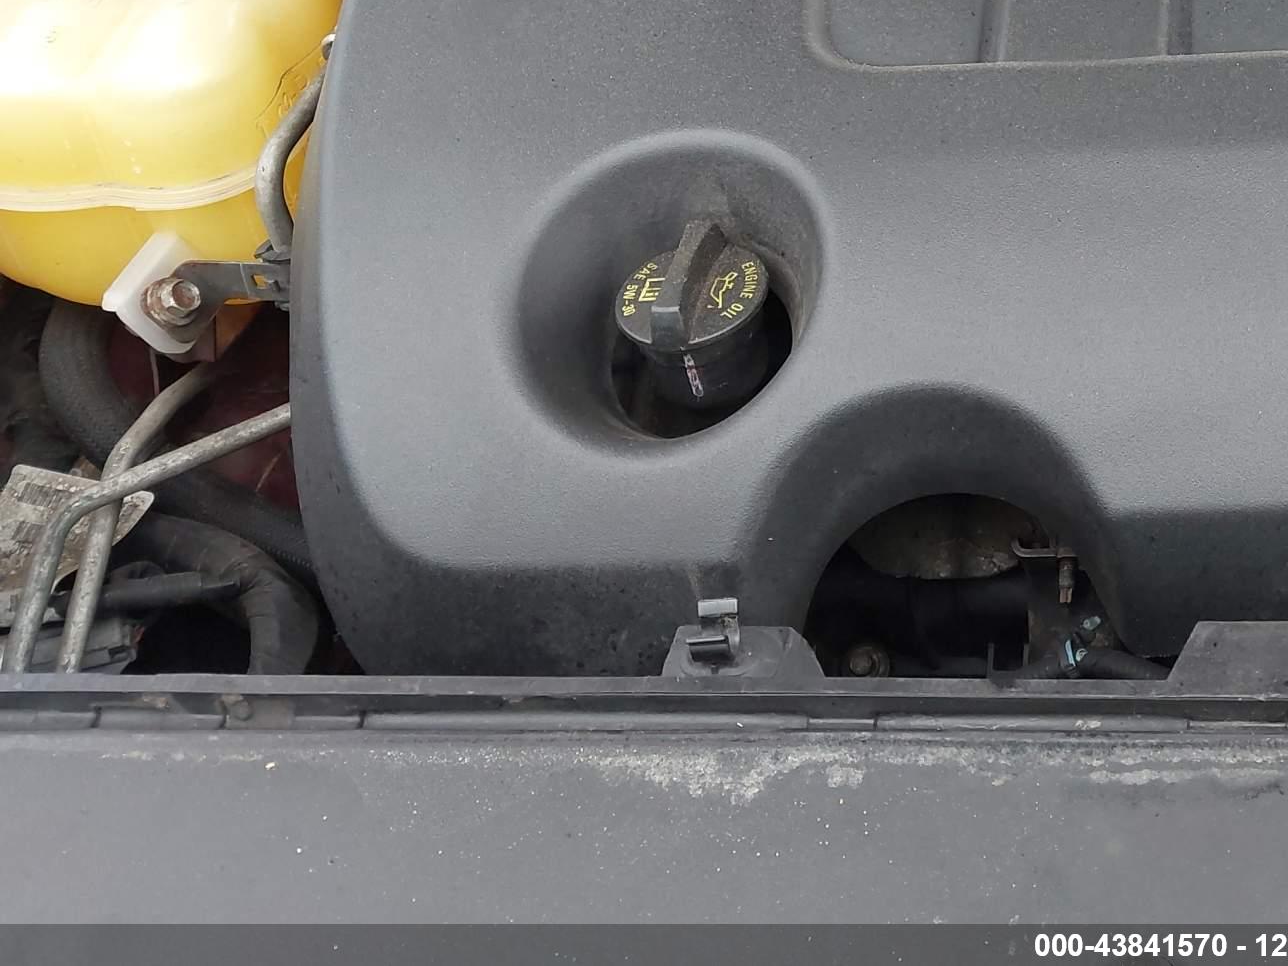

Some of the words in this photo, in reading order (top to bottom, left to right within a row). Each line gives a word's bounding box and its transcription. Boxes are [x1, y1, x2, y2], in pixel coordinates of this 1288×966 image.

[633, 262, 659, 282] SAE
[740, 261, 759, 300] ENGINE
[621, 284, 639, 318] 5W-30
[720, 302, 745, 320] OIL
